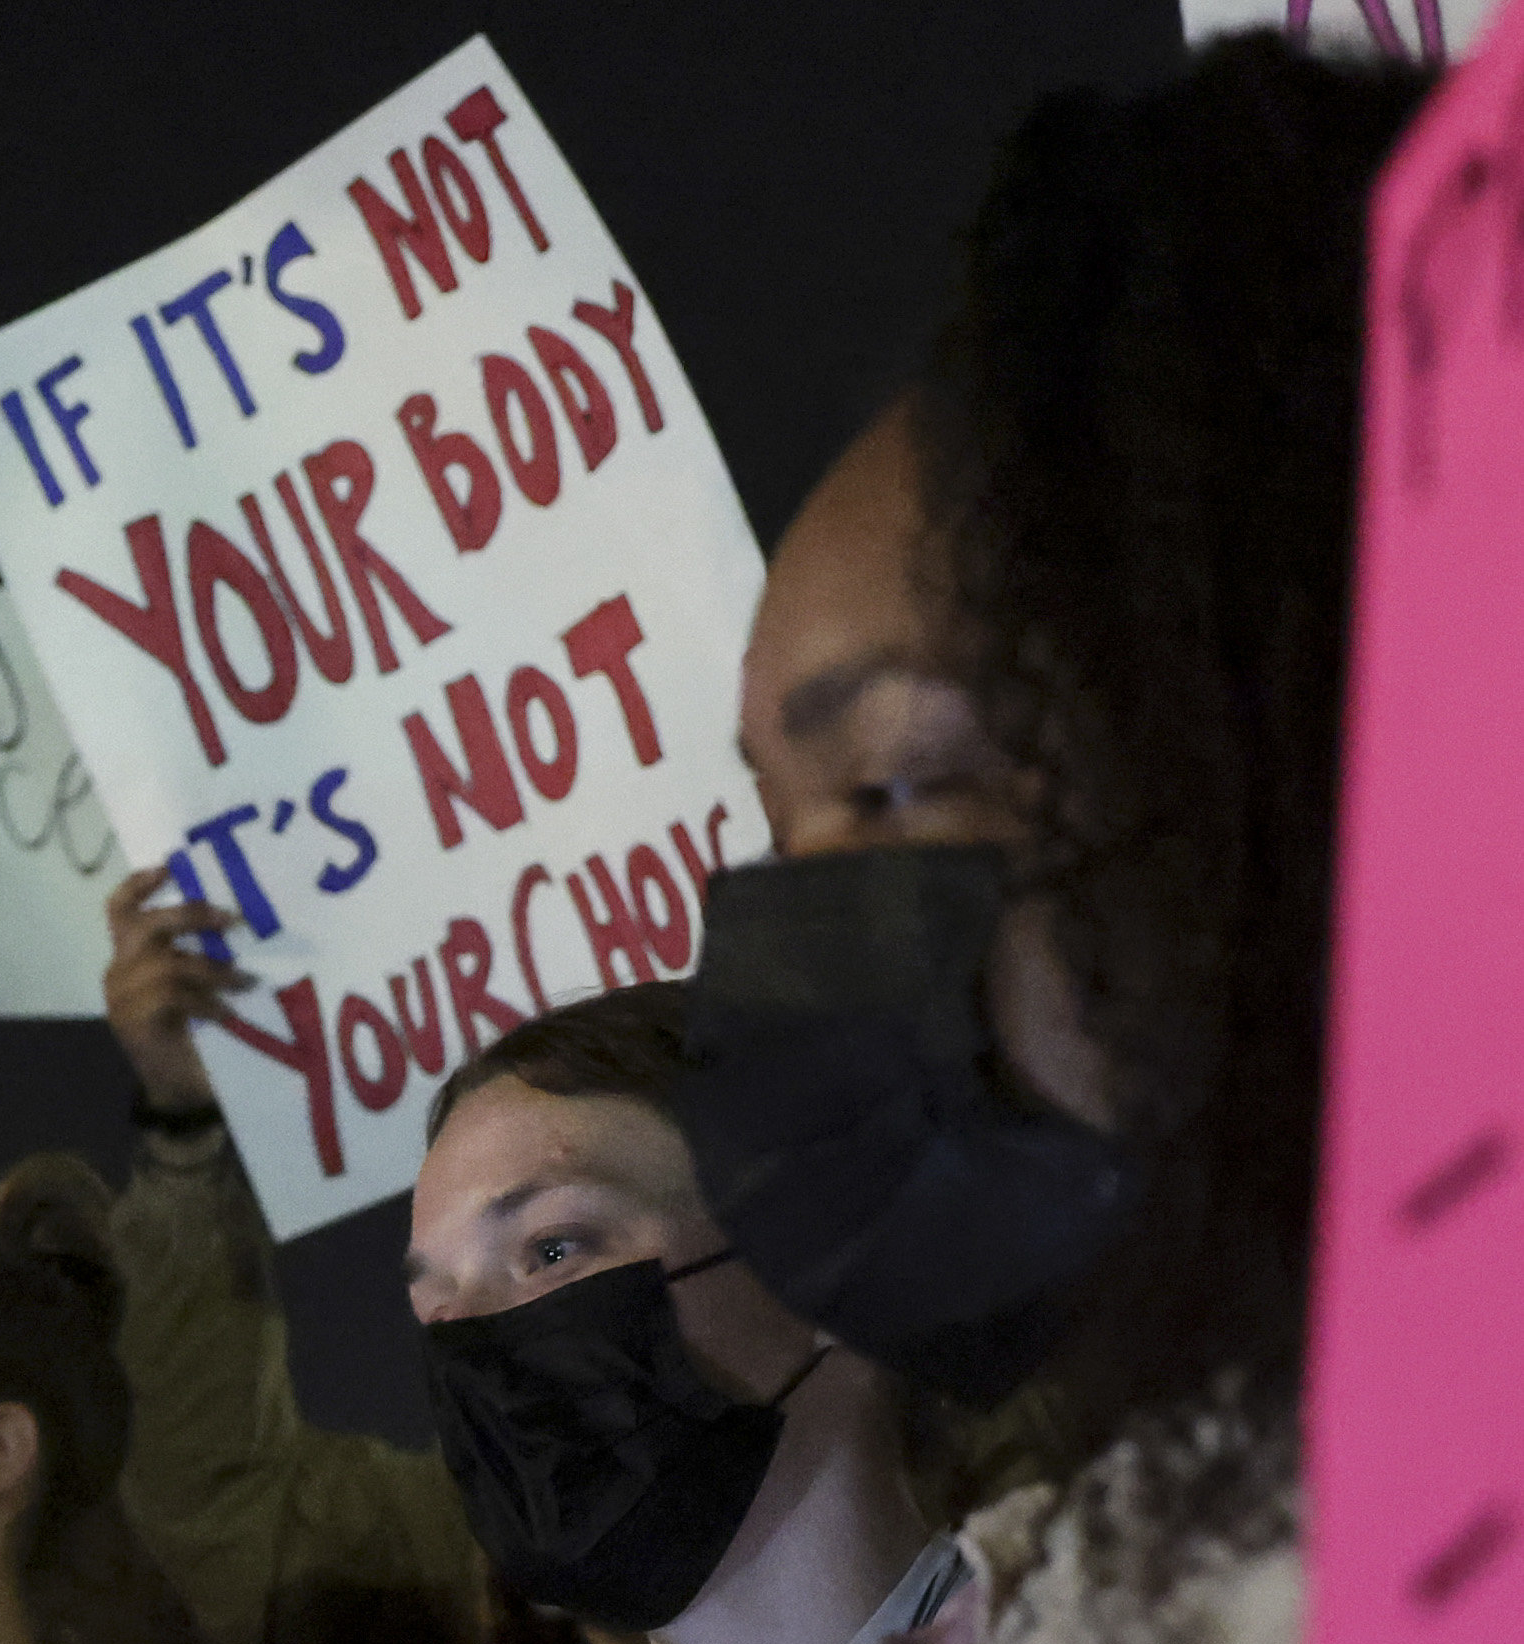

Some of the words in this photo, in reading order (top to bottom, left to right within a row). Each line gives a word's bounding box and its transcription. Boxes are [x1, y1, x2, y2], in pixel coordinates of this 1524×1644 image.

[0, 354, 103, 509] IF
[129, 220, 348, 451] IT'S
[345, 84, 551, 321] NOT
[54, 437, 454, 768] YOUR
[395, 280, 666, 556] BODY
[164, 767, 380, 965] IT'S
[401, 592, 665, 853] NOT
[217, 916, 531, 1180] YOUR
